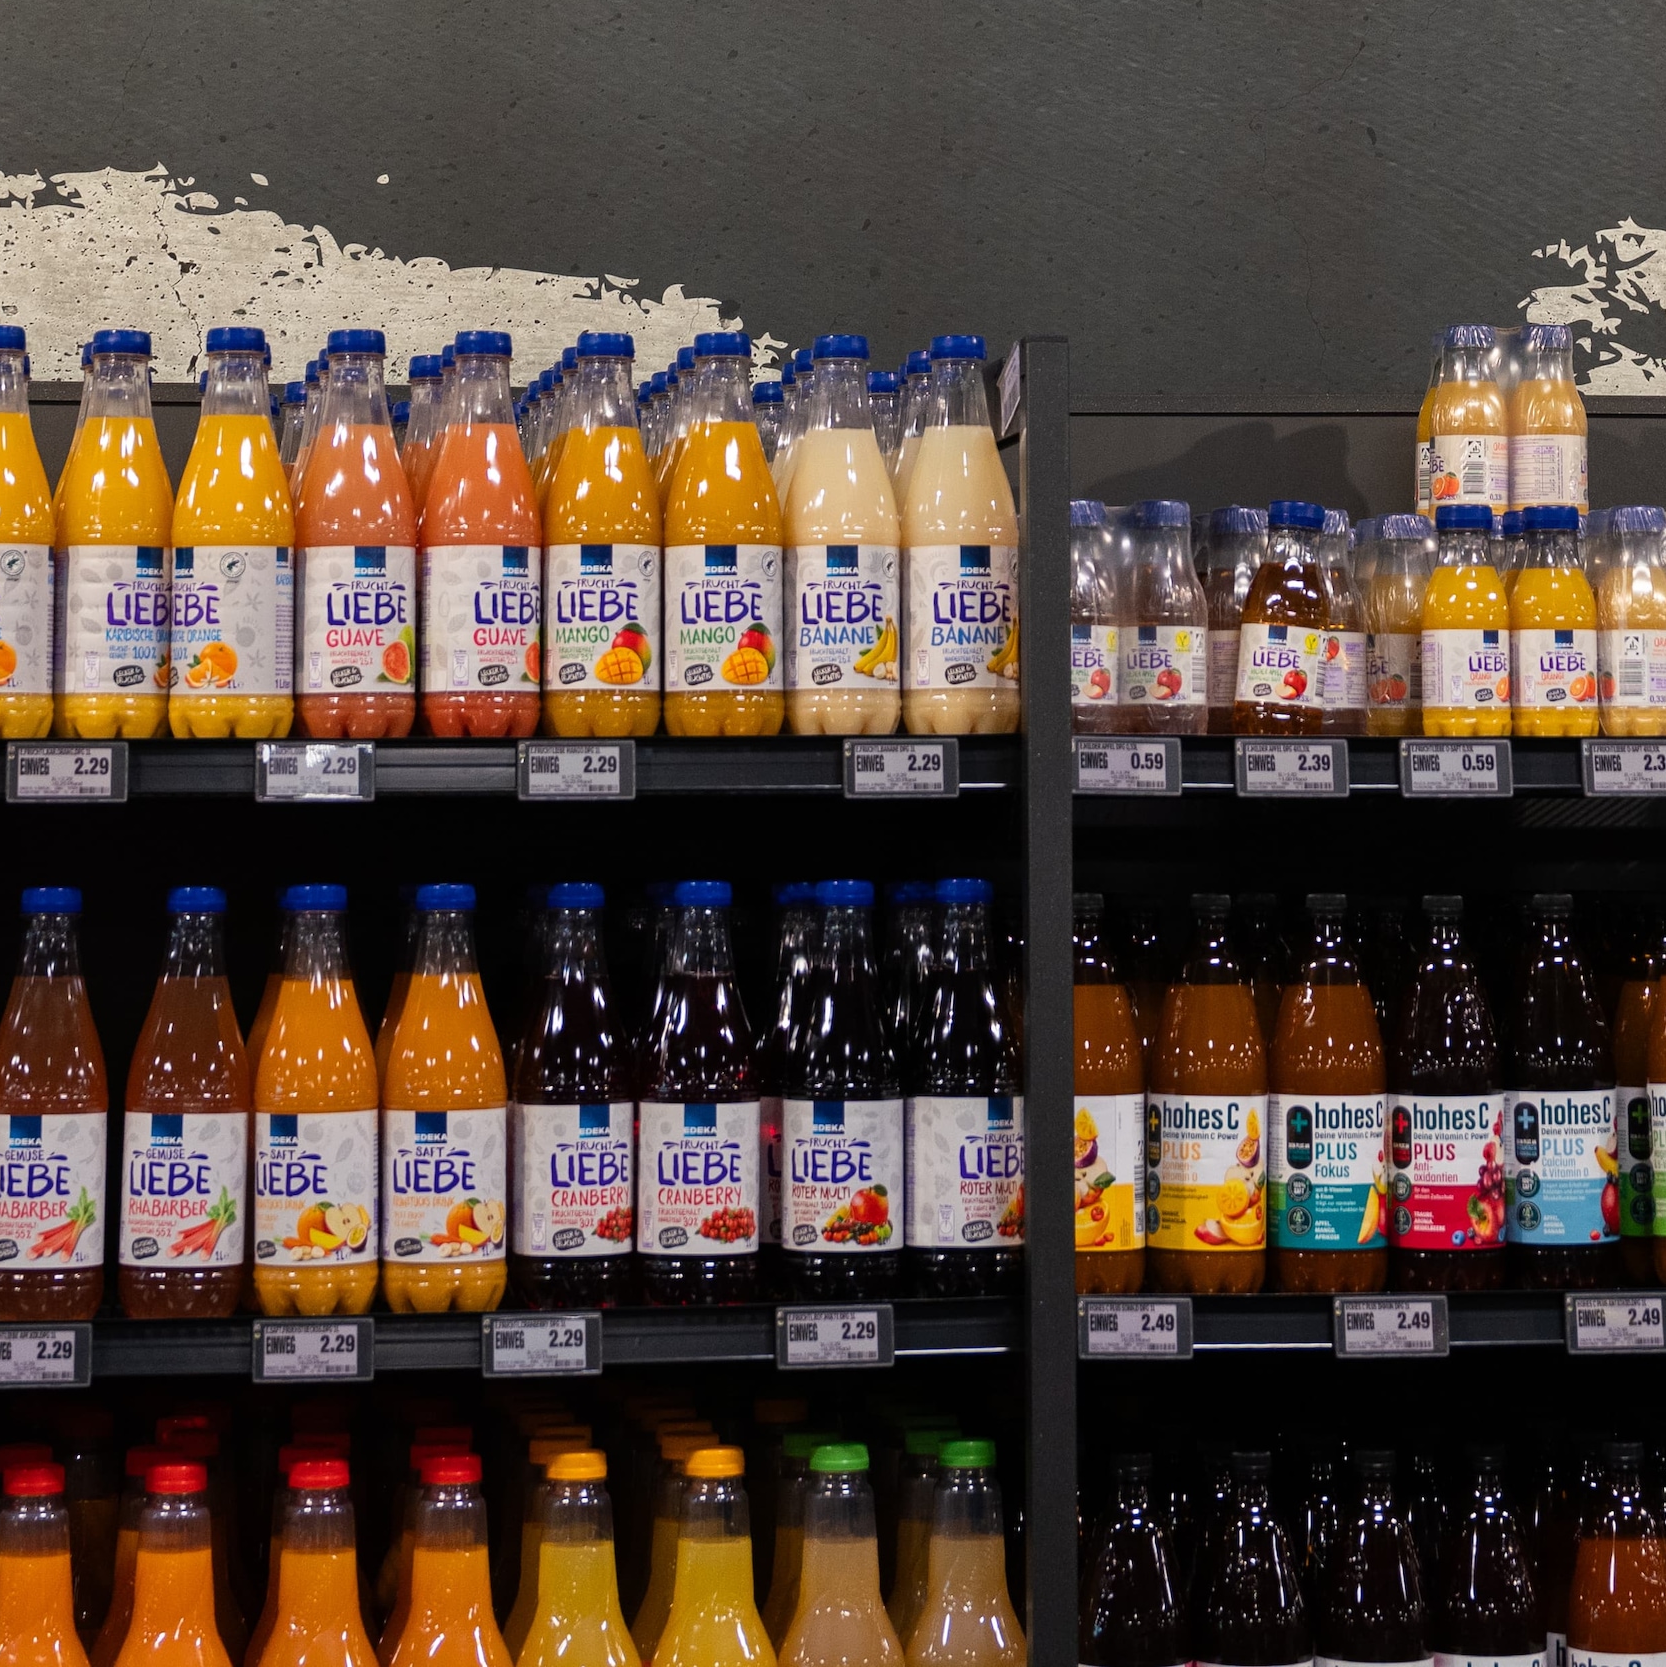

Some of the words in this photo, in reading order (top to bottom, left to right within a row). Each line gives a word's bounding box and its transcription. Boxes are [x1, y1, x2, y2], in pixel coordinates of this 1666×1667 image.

[327, 593, 407, 625] LIEBE
[555, 591, 639, 624] LIEBE
[799, 591, 884, 624] LIEBE
[326, 628, 385, 648] GUAVE
[555, 626, 609, 644] MANGO
[799, 626, 875, 646] BANANE
[1252, 650, 1301, 668] LIEBE
[1540, 654, 1587, 672] LIEBE
[74, 757, 109, 776] 2.29
[530, 755, 560, 774] EINWEG
[582, 755, 617, 774] 2.29
[907, 753, 942, 771] 2.29
[1081, 752, 1108, 770] EINWEG
[1131, 752, 1163, 770] 0.59
[1297, 754, 1331, 772] 2.39
[1461, 754, 1495, 771] 0.59
[1315, 1142, 1358, 1161] PLUS
[1413, 1142, 1456, 1161] PLUS
[1543, 1138, 1585, 1156] PLUS
[657, 1151, 741, 1186] LIEBE
[791, 1150, 873, 1184] LIEBE
[1315, 1163, 1351, 1178] Fokus
[393, 1159, 475, 1194] LIEBE
[657, 1186, 741, 1206] CRANBERRY
[792, 1184, 818, 1199] ROTER
[820, 1184, 851, 1199] MULTI
[1141, 1314, 1175, 1333] 2.49
[1397, 1312, 1431, 1330] 2.49
[1627, 1308, 1661, 1326] 2.49
[549, 1330, 583, 1348] 2.29
[841, 1322, 876, 1340] 2.29
[36, 1342, 73, 1360] 2.29
[319, 1334, 355, 1354] 2.29
